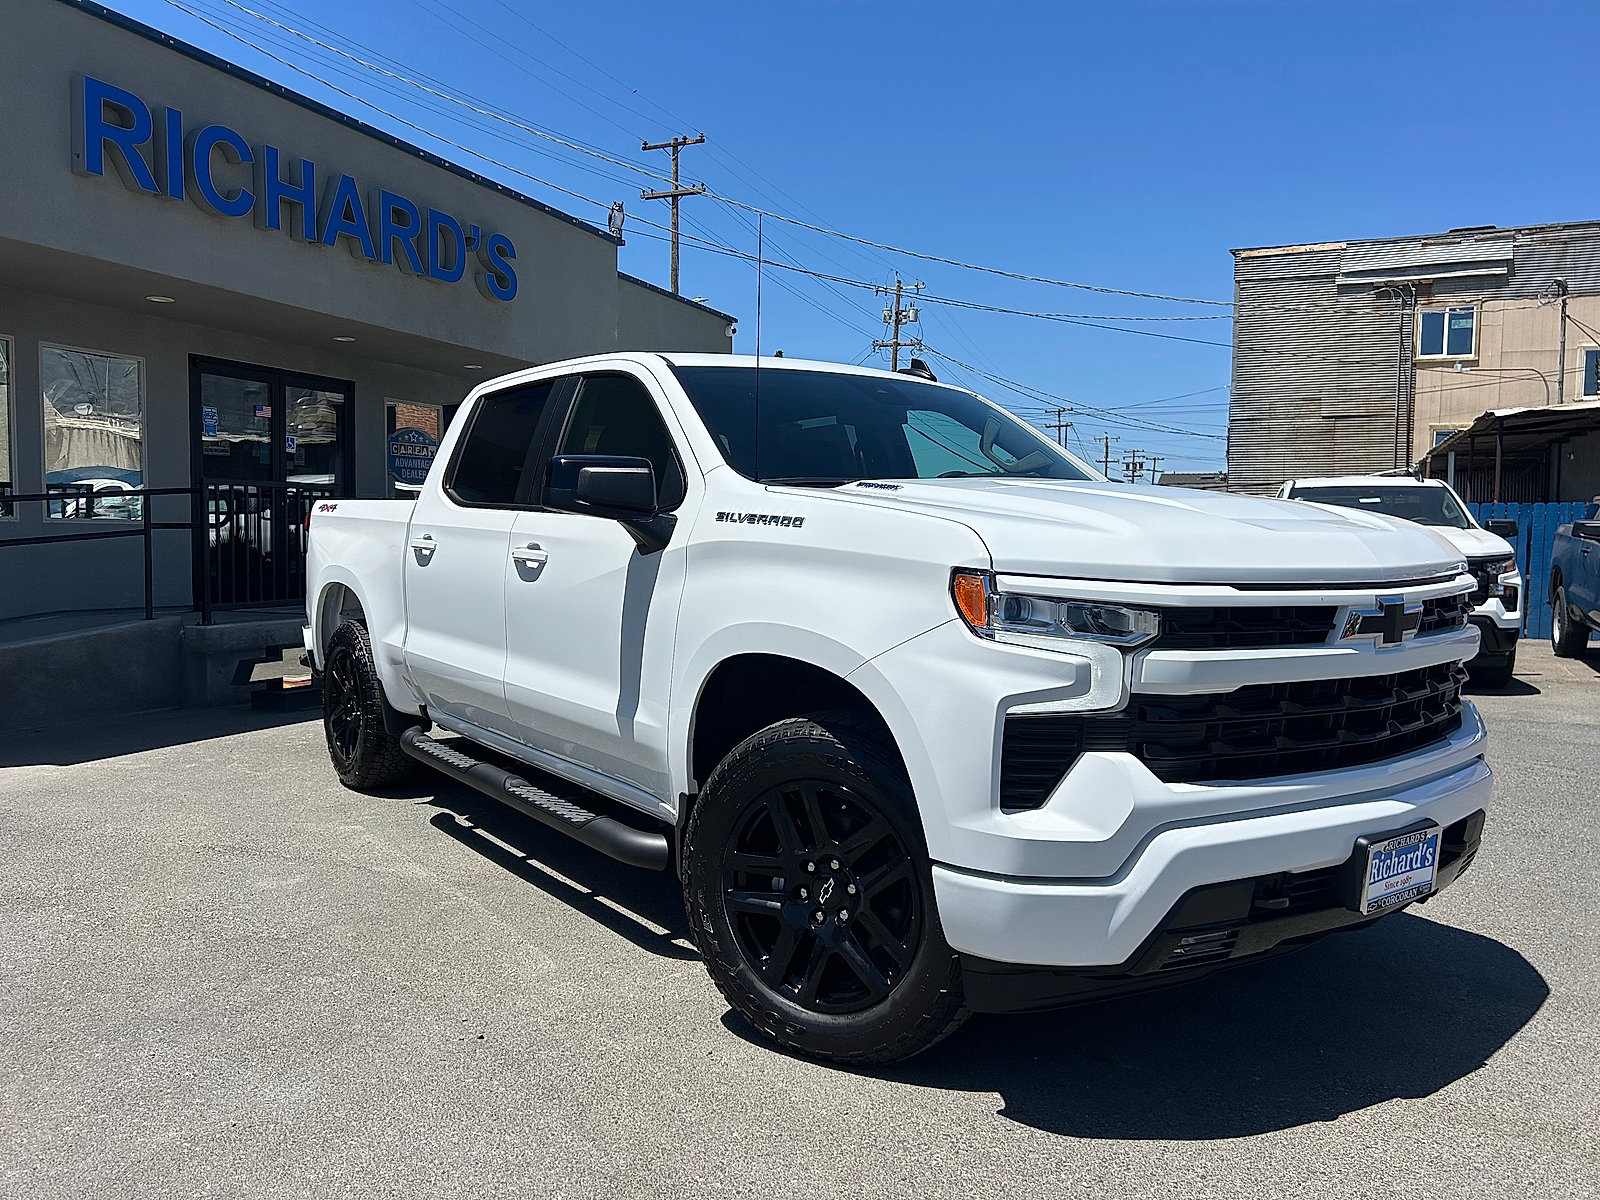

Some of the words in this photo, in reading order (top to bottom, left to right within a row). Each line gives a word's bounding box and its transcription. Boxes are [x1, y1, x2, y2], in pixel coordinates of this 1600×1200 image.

[83, 75, 518, 302] RICHARD'S
[401, 468, 427, 480] DEALER
[715, 511, 806, 528] SILVERADO
[1370, 843, 1433, 883] Richard's
[1384, 880, 1399, 891] Since
[1381, 887, 1418, 907] CORCORAN
